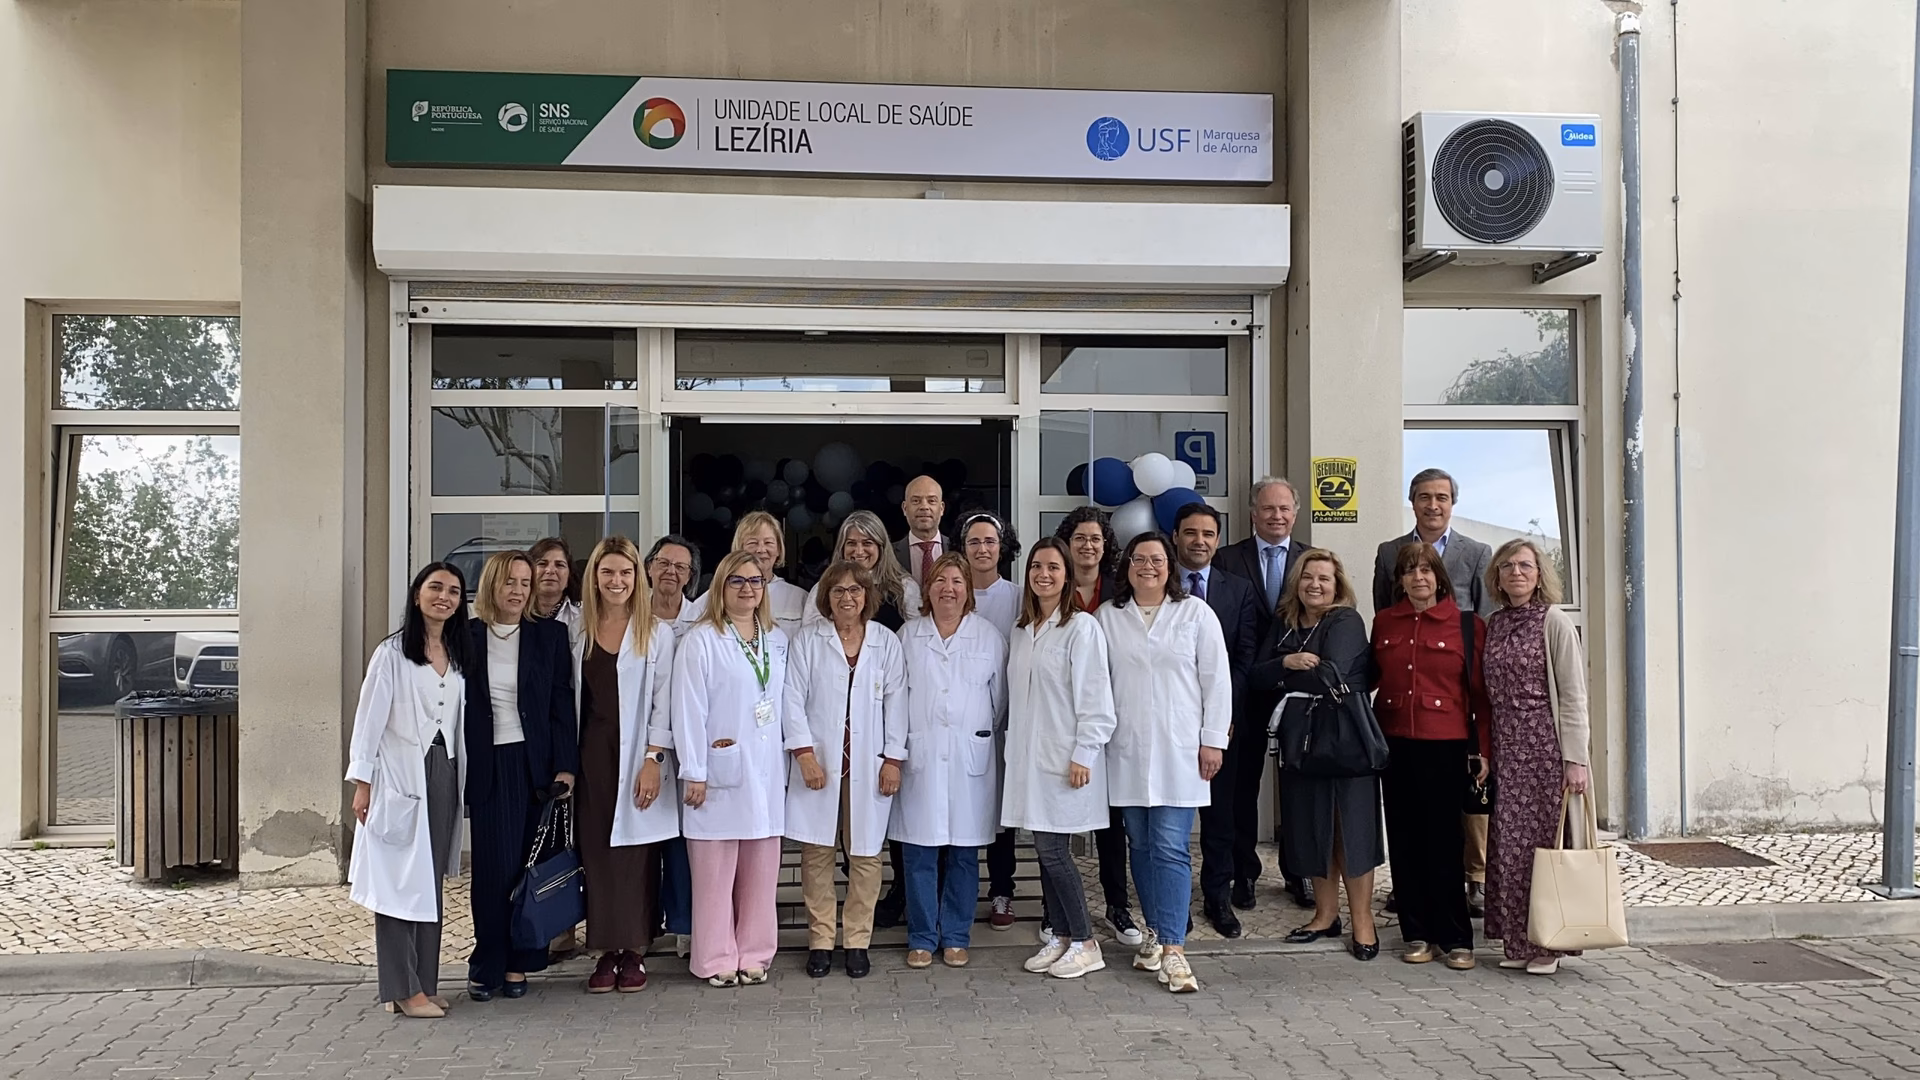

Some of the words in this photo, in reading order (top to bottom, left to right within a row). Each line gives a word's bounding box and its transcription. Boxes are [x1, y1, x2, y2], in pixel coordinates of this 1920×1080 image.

[431, 105, 473, 113] REPÚBLICA
[539, 103, 570, 118] SNS
[714, 99, 801, 122] UNIDADE
[807, 101, 872, 124] LOCAL
[877, 103, 903, 125] DE
[909, 101, 974, 127] SAÚDE
[431, 112, 482, 120] PORTUGUESA
[539, 118, 562, 126] SERVIÇO
[547, 126, 566, 134] SAÚDE
[1203, 129, 1260, 143] Marquesa
[1563, 129, 1594, 141] Midea
[715, 122, 813, 154] LEZÍRIA
[1138, 128, 1191, 153] USF
[1203, 142, 1218, 153] de
[1220, 143, 1258, 154] Alorna
[1320, 481, 1350, 496] 24
